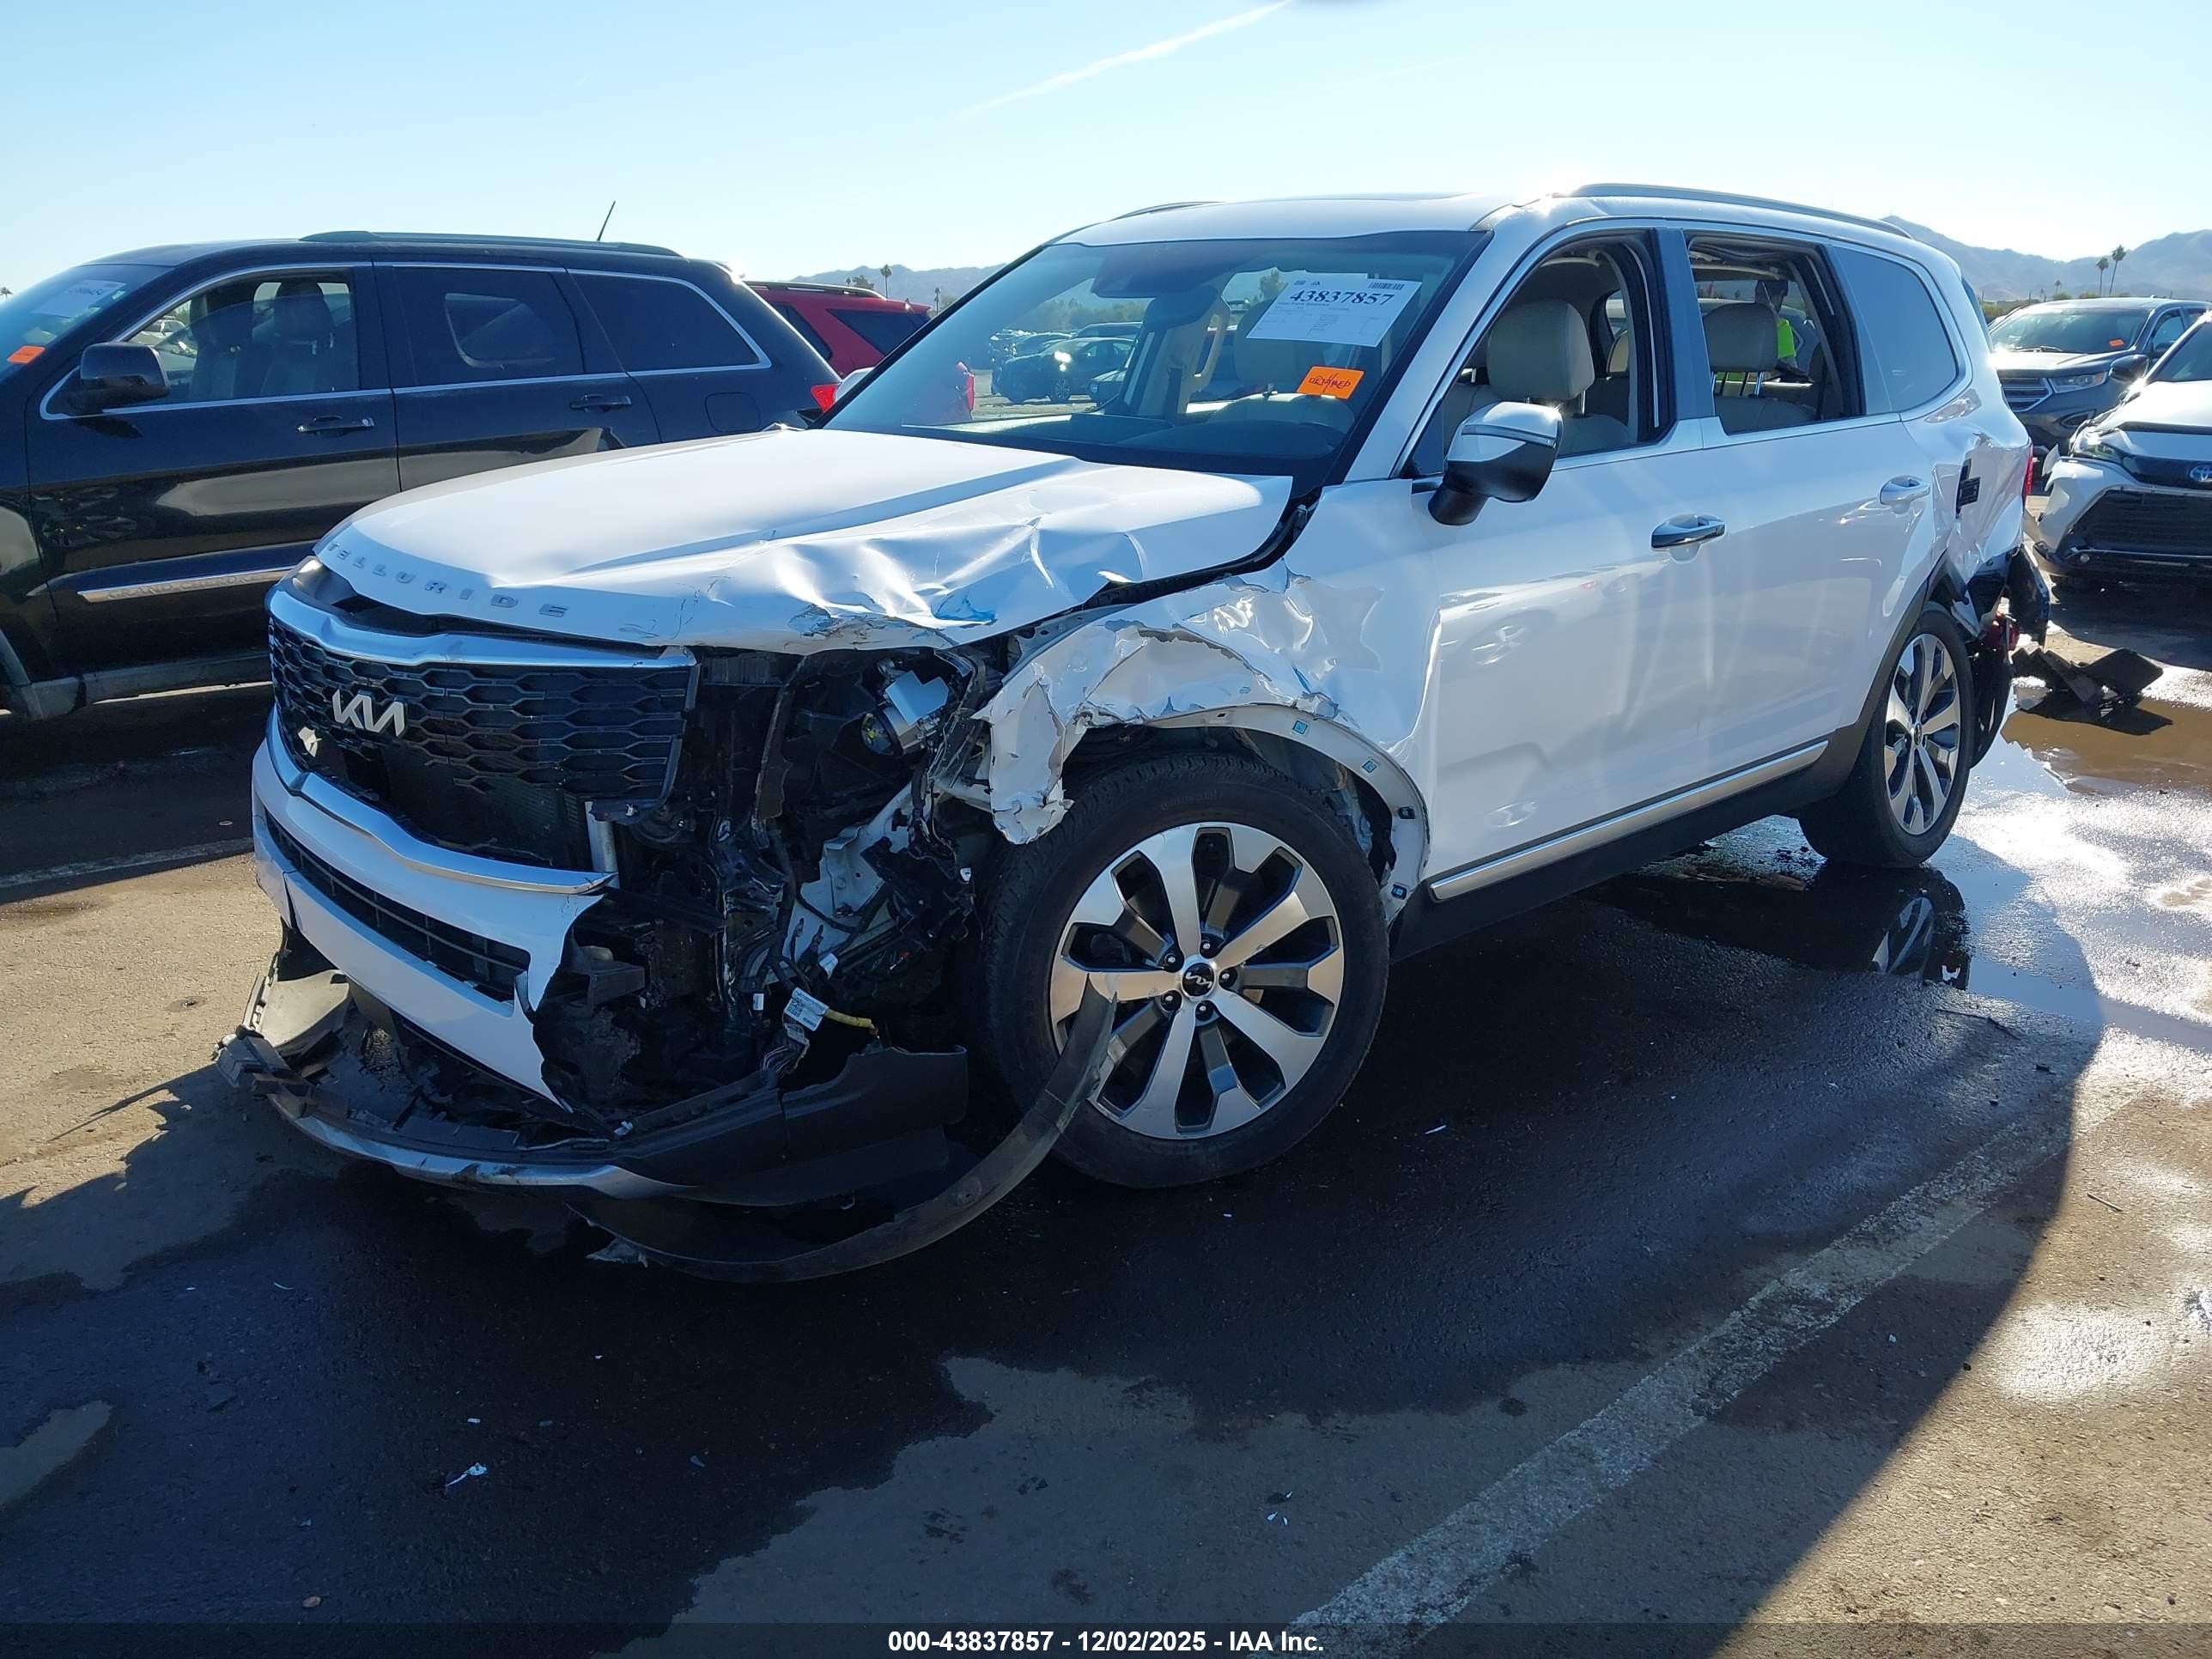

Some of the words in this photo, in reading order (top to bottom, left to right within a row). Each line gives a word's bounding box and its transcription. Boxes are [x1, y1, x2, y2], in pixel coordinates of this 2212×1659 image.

[1289, 290, 1396, 306] 43837857
[327, 542, 570, 617] TELLURIDE
[331, 688, 405, 737] KIA
